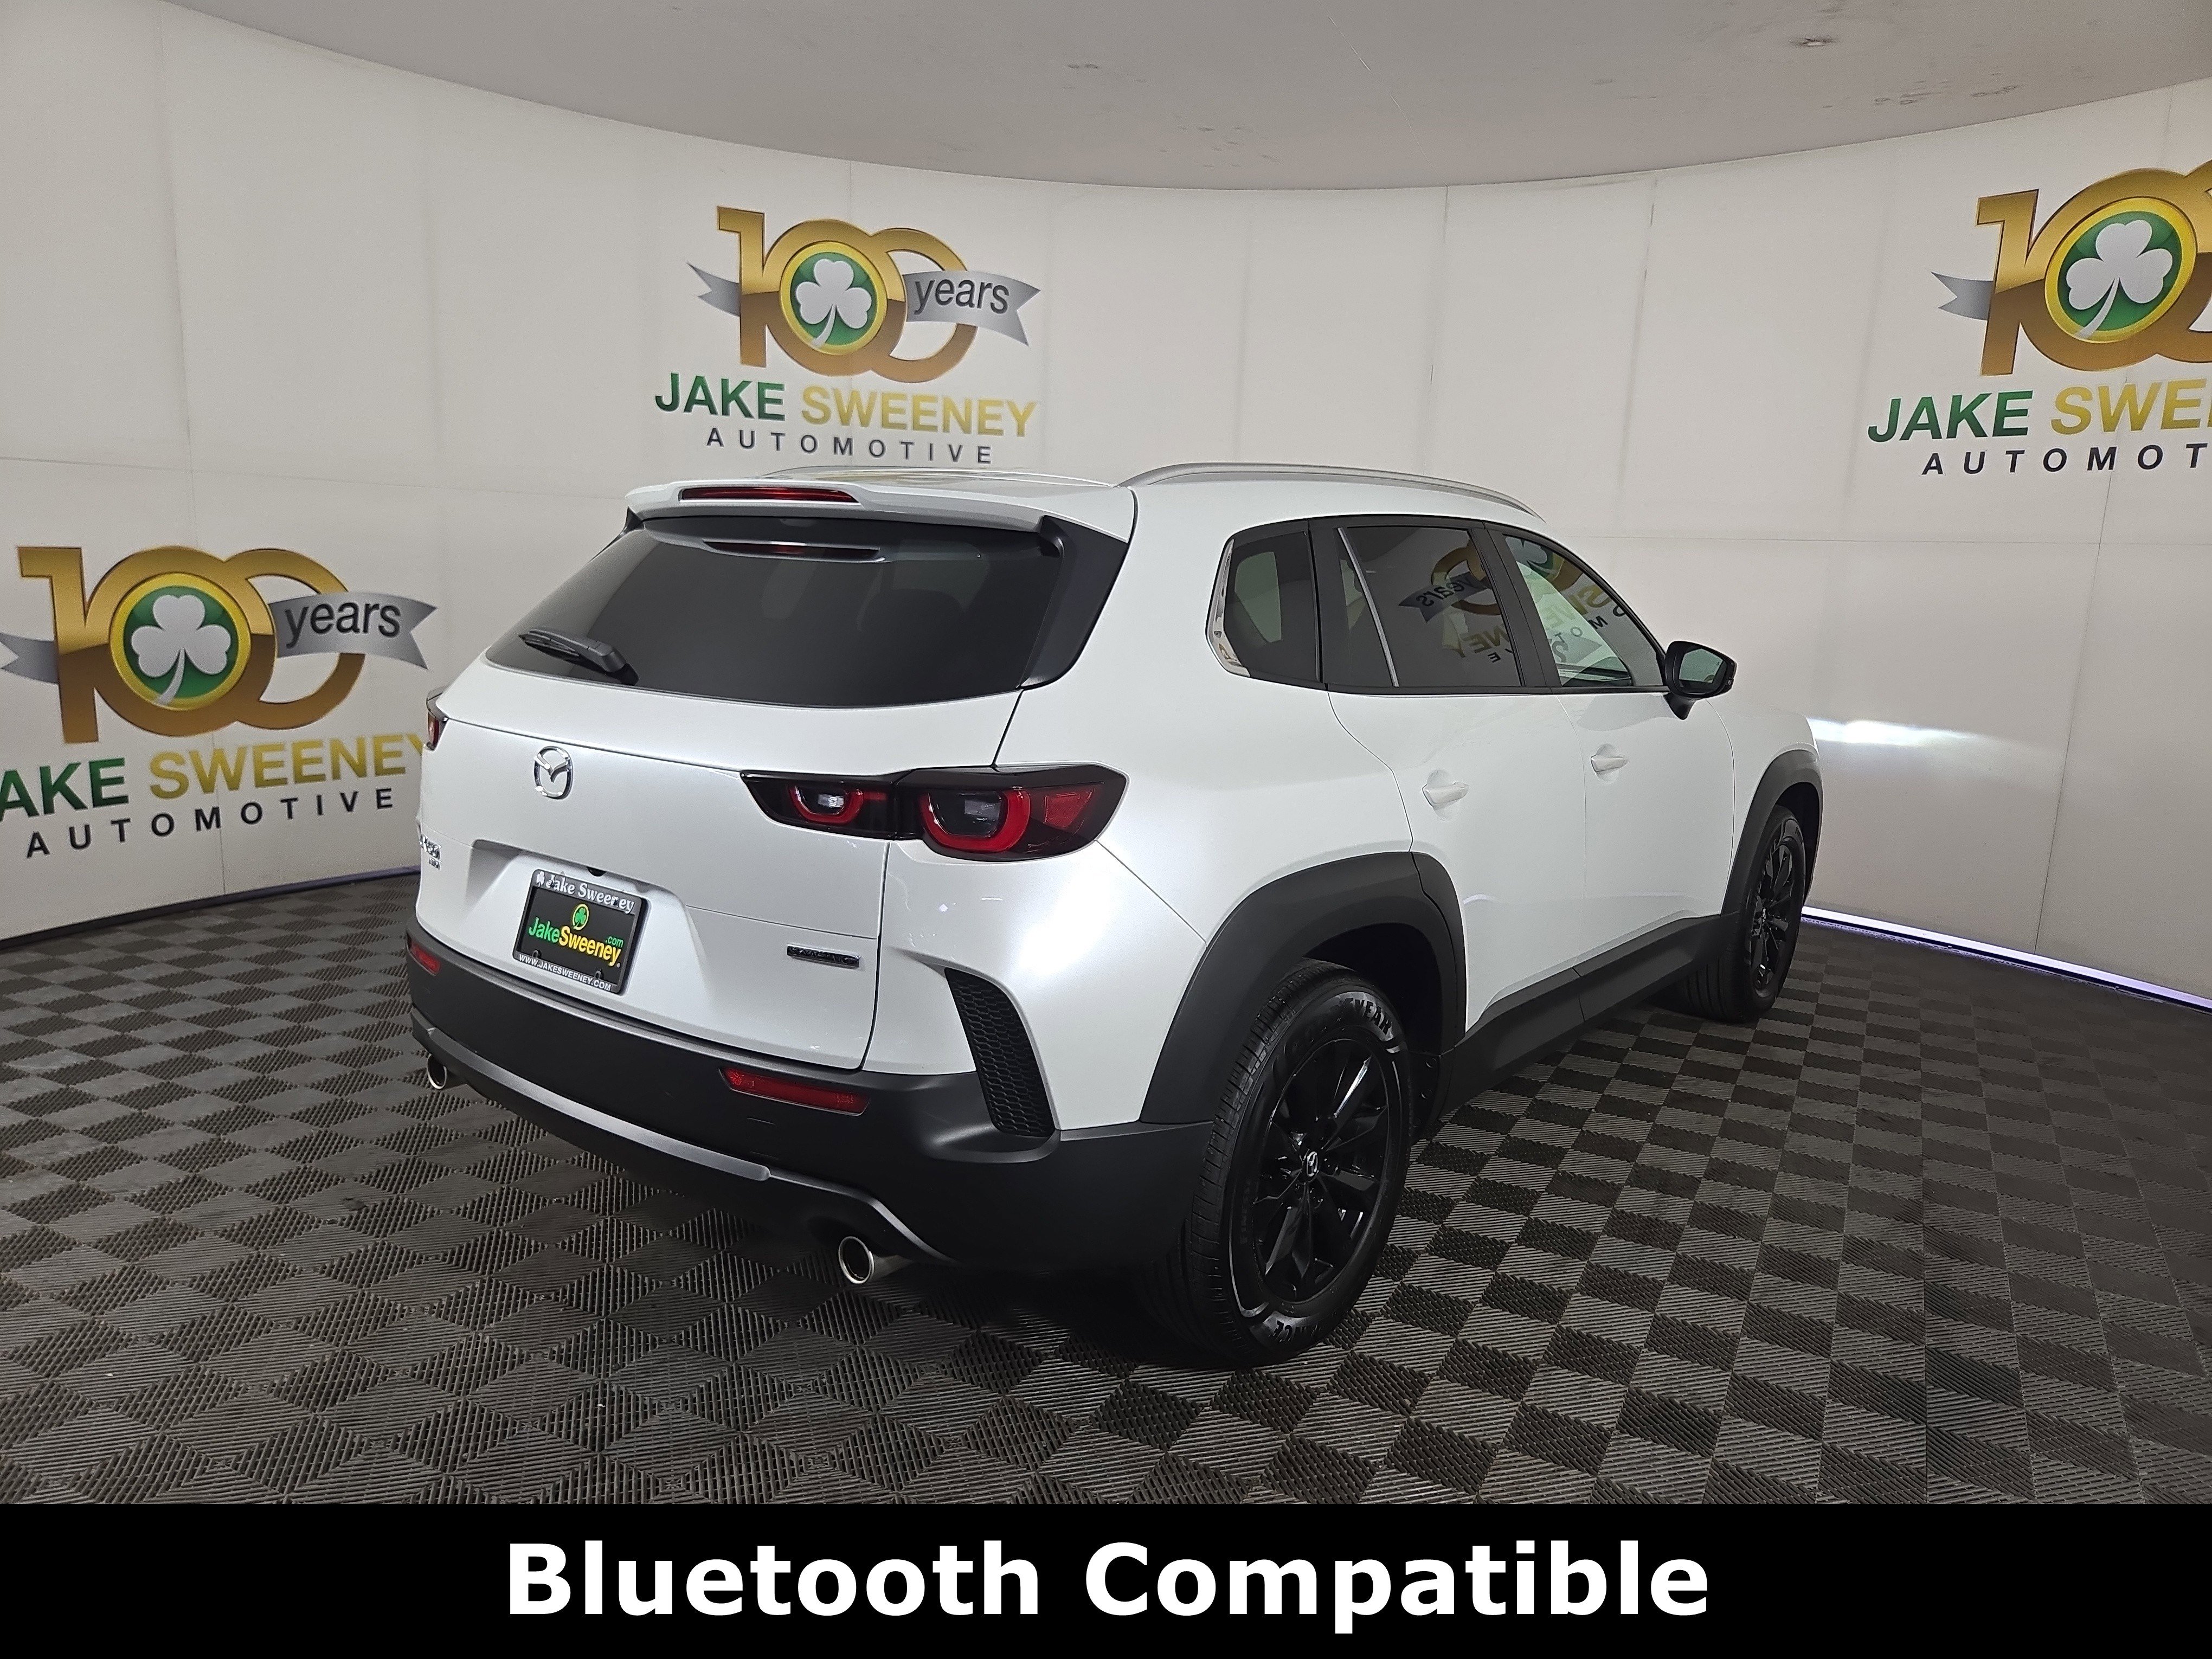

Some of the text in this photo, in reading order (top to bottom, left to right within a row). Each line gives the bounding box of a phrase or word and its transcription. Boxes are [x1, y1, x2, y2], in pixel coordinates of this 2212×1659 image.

[1976, 159, 2212, 376] 10
[913, 274, 1010, 315] years
[655, 372, 1037, 437] JAKE SWEENEY
[1867, 378, 2212, 442] JAKE SWE
[706, 427, 992, 464] AUTOMOTIVE
[1921, 442, 2208, 475] AUTOMOT
[285, 601, 401, 648] years
[27, 788, 393, 858] AUTOMOTIVE
[528, 916, 622, 967] JakeSweeney
[605, 936, 624, 948] .com
[519, 954, 612, 991] WWW.JAKESWEENEY.COM
